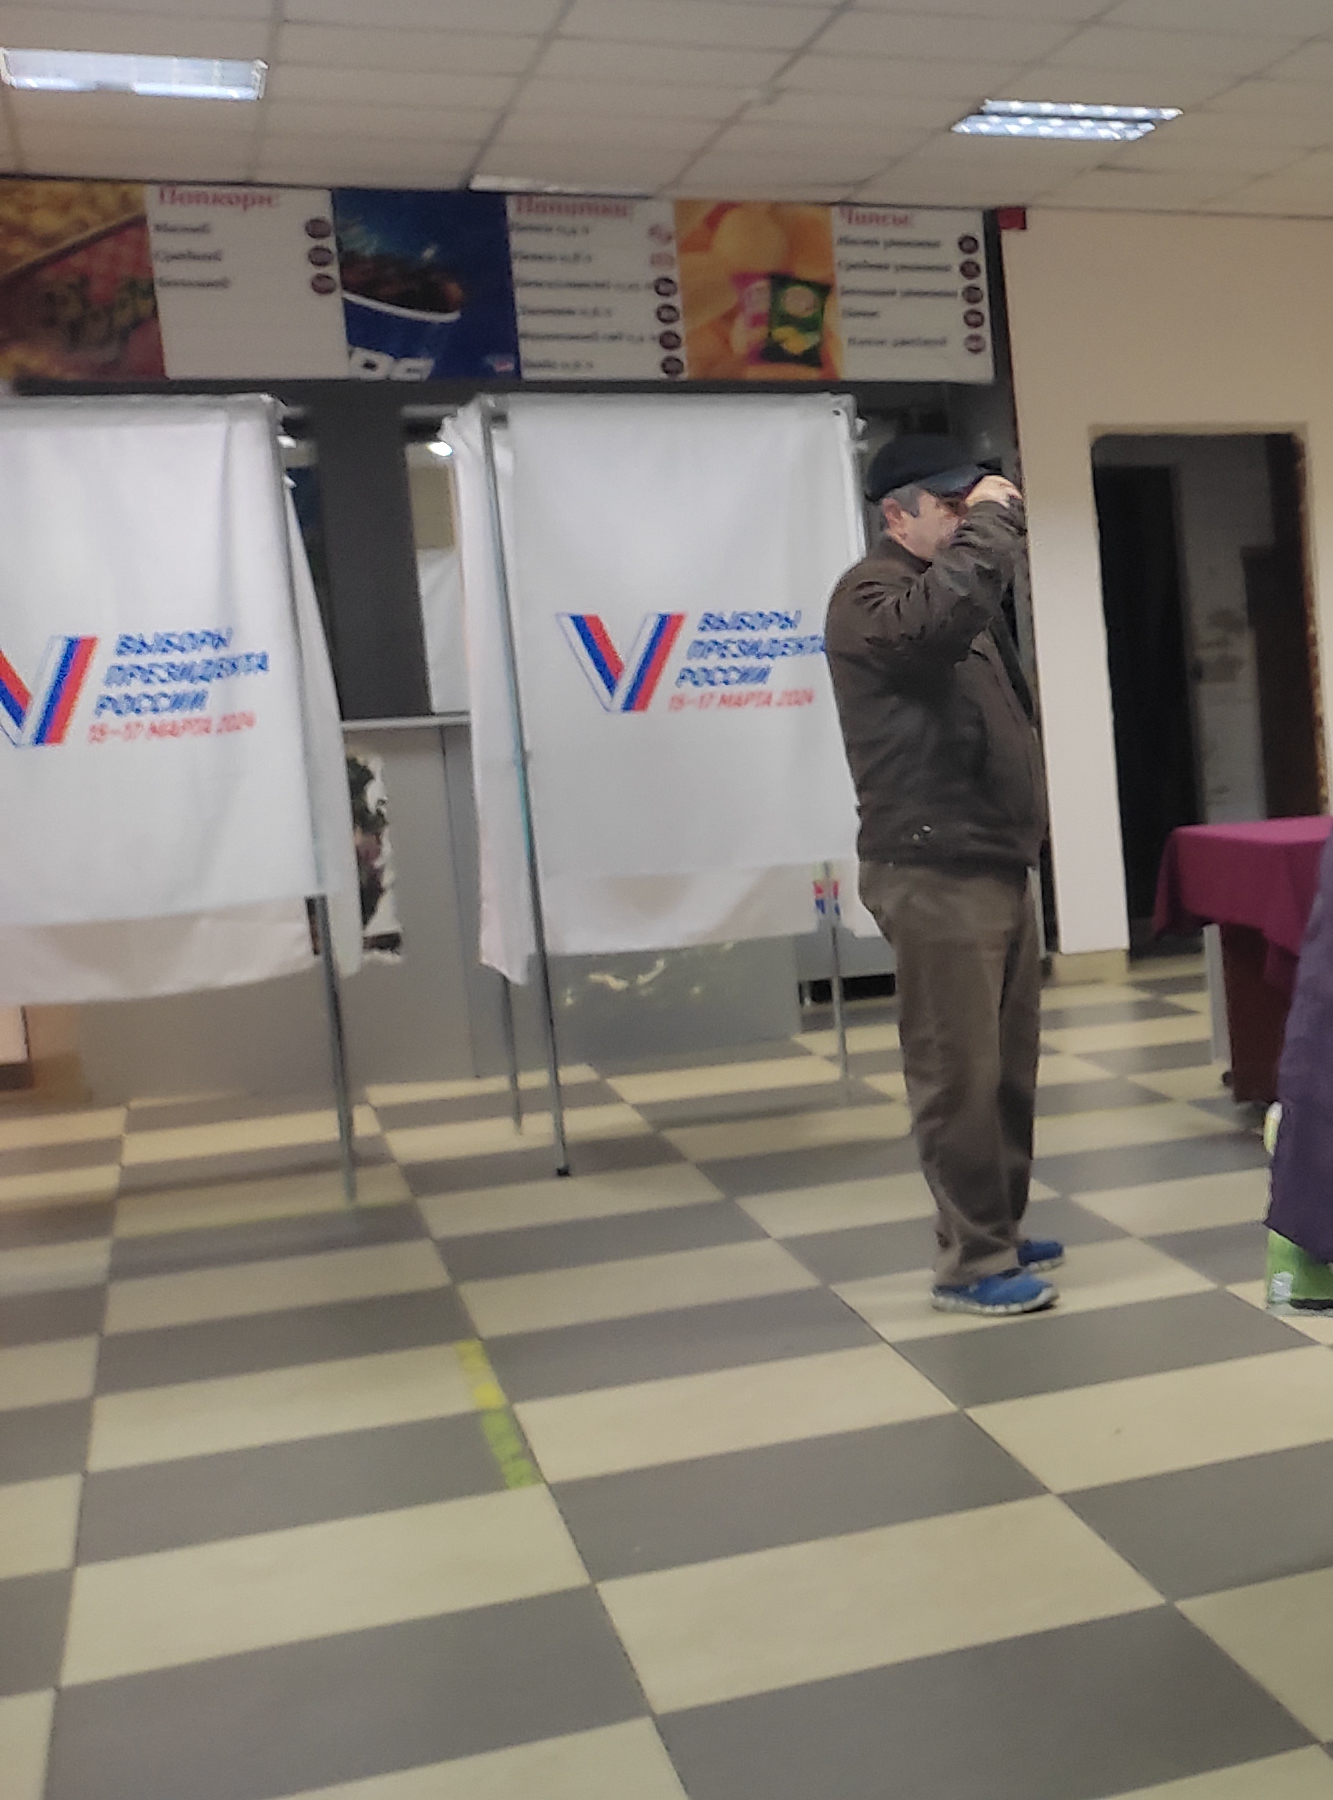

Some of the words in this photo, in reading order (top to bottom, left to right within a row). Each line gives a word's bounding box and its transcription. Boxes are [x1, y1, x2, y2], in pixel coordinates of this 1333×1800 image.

[698, 610, 801, 631] ВЫБОРЫ
[116, 627, 232, 657] ВЫБОРЫ
[675, 666, 772, 688] РОССИИ
[95, 690, 209, 717] РОССИИ
